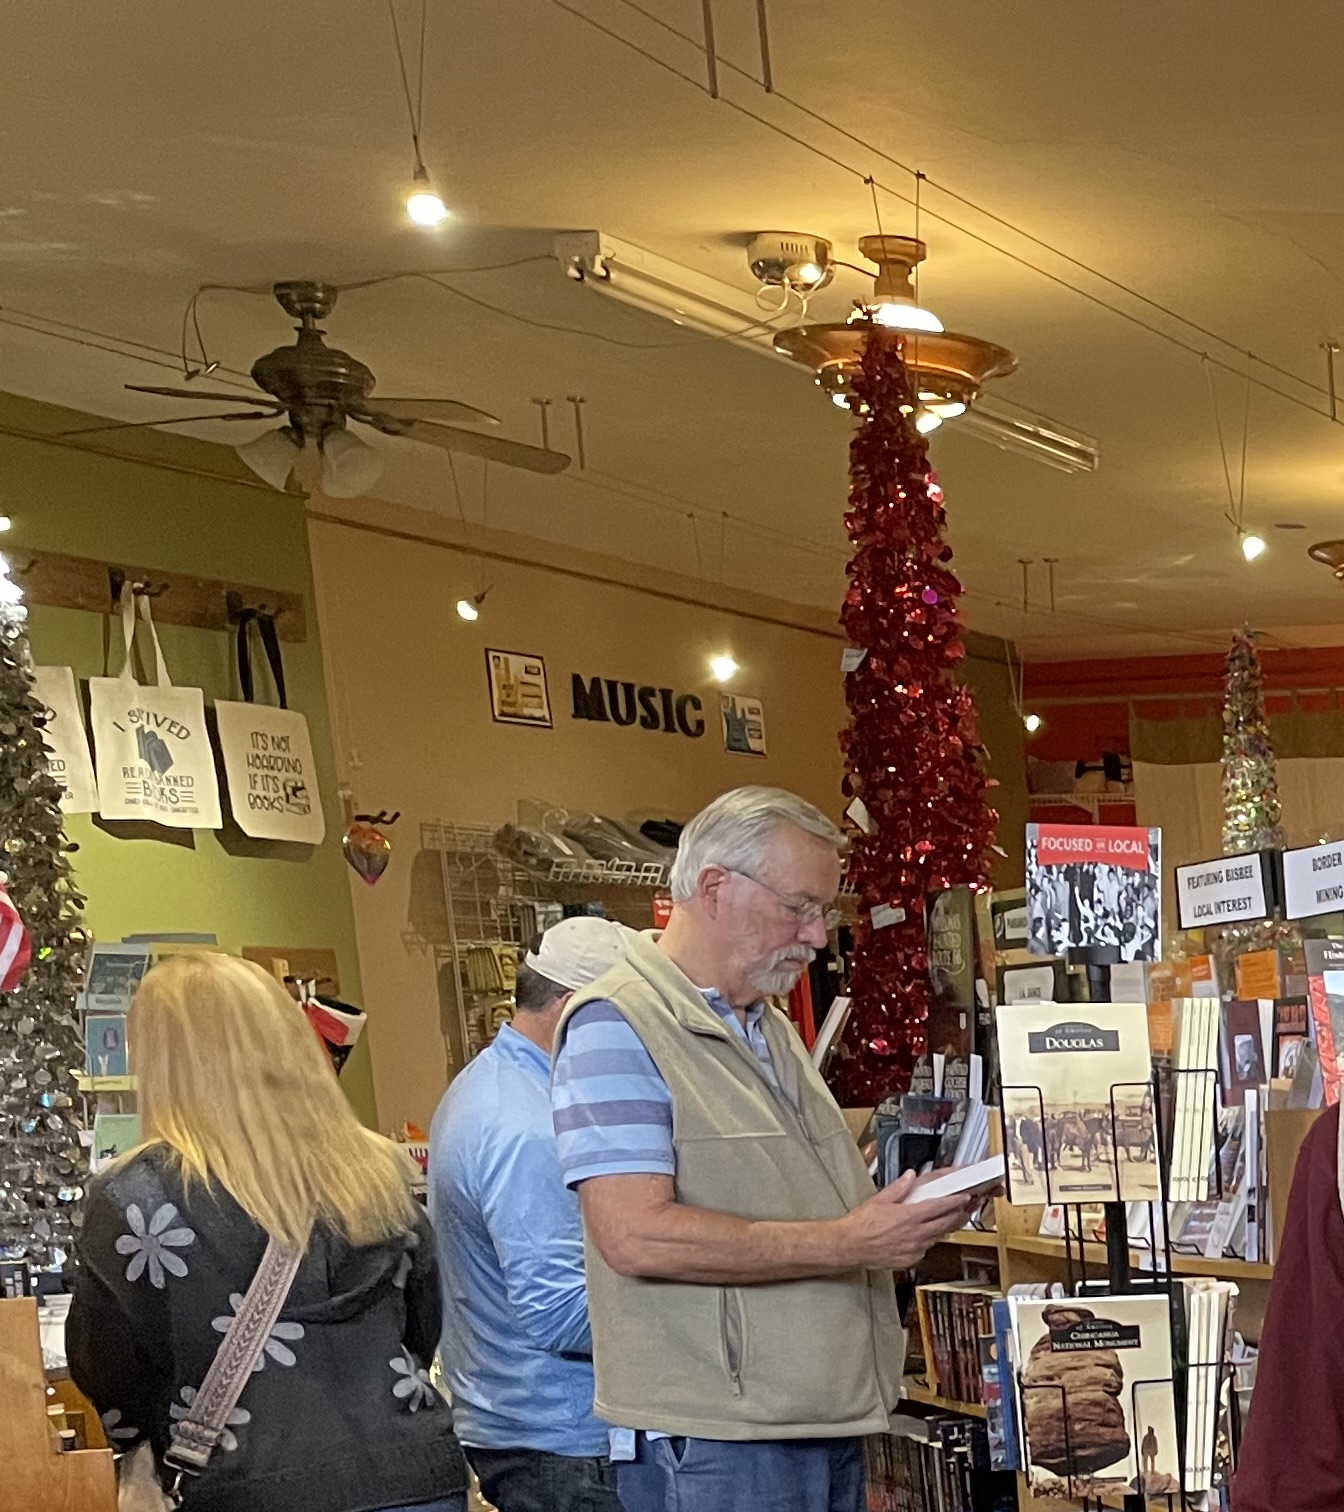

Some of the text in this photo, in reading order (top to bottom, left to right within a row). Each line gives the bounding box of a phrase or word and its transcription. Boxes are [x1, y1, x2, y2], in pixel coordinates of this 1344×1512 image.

[571, 673, 705, 737] MUSIC
[270, 735, 291, 752] NOT
[246, 754, 303, 776] HOARDING
[247, 793, 284, 813] BOOKS
[1041, 837, 1092, 852] FOCUSED
[1108, 839, 1145, 854] LOCAL
[1312, 852, 1343, 872] BORDER
[1187, 865, 1254, 890] FEATURING BISBEE
[1315, 885, 1344, 904] MINING
[1193, 896, 1252, 918] LOCAL INTEREST
[1045, 1037, 1104, 1049] DOUGLAS
[1053, 1339, 1138, 1350] NATIONAL MONUMENT
